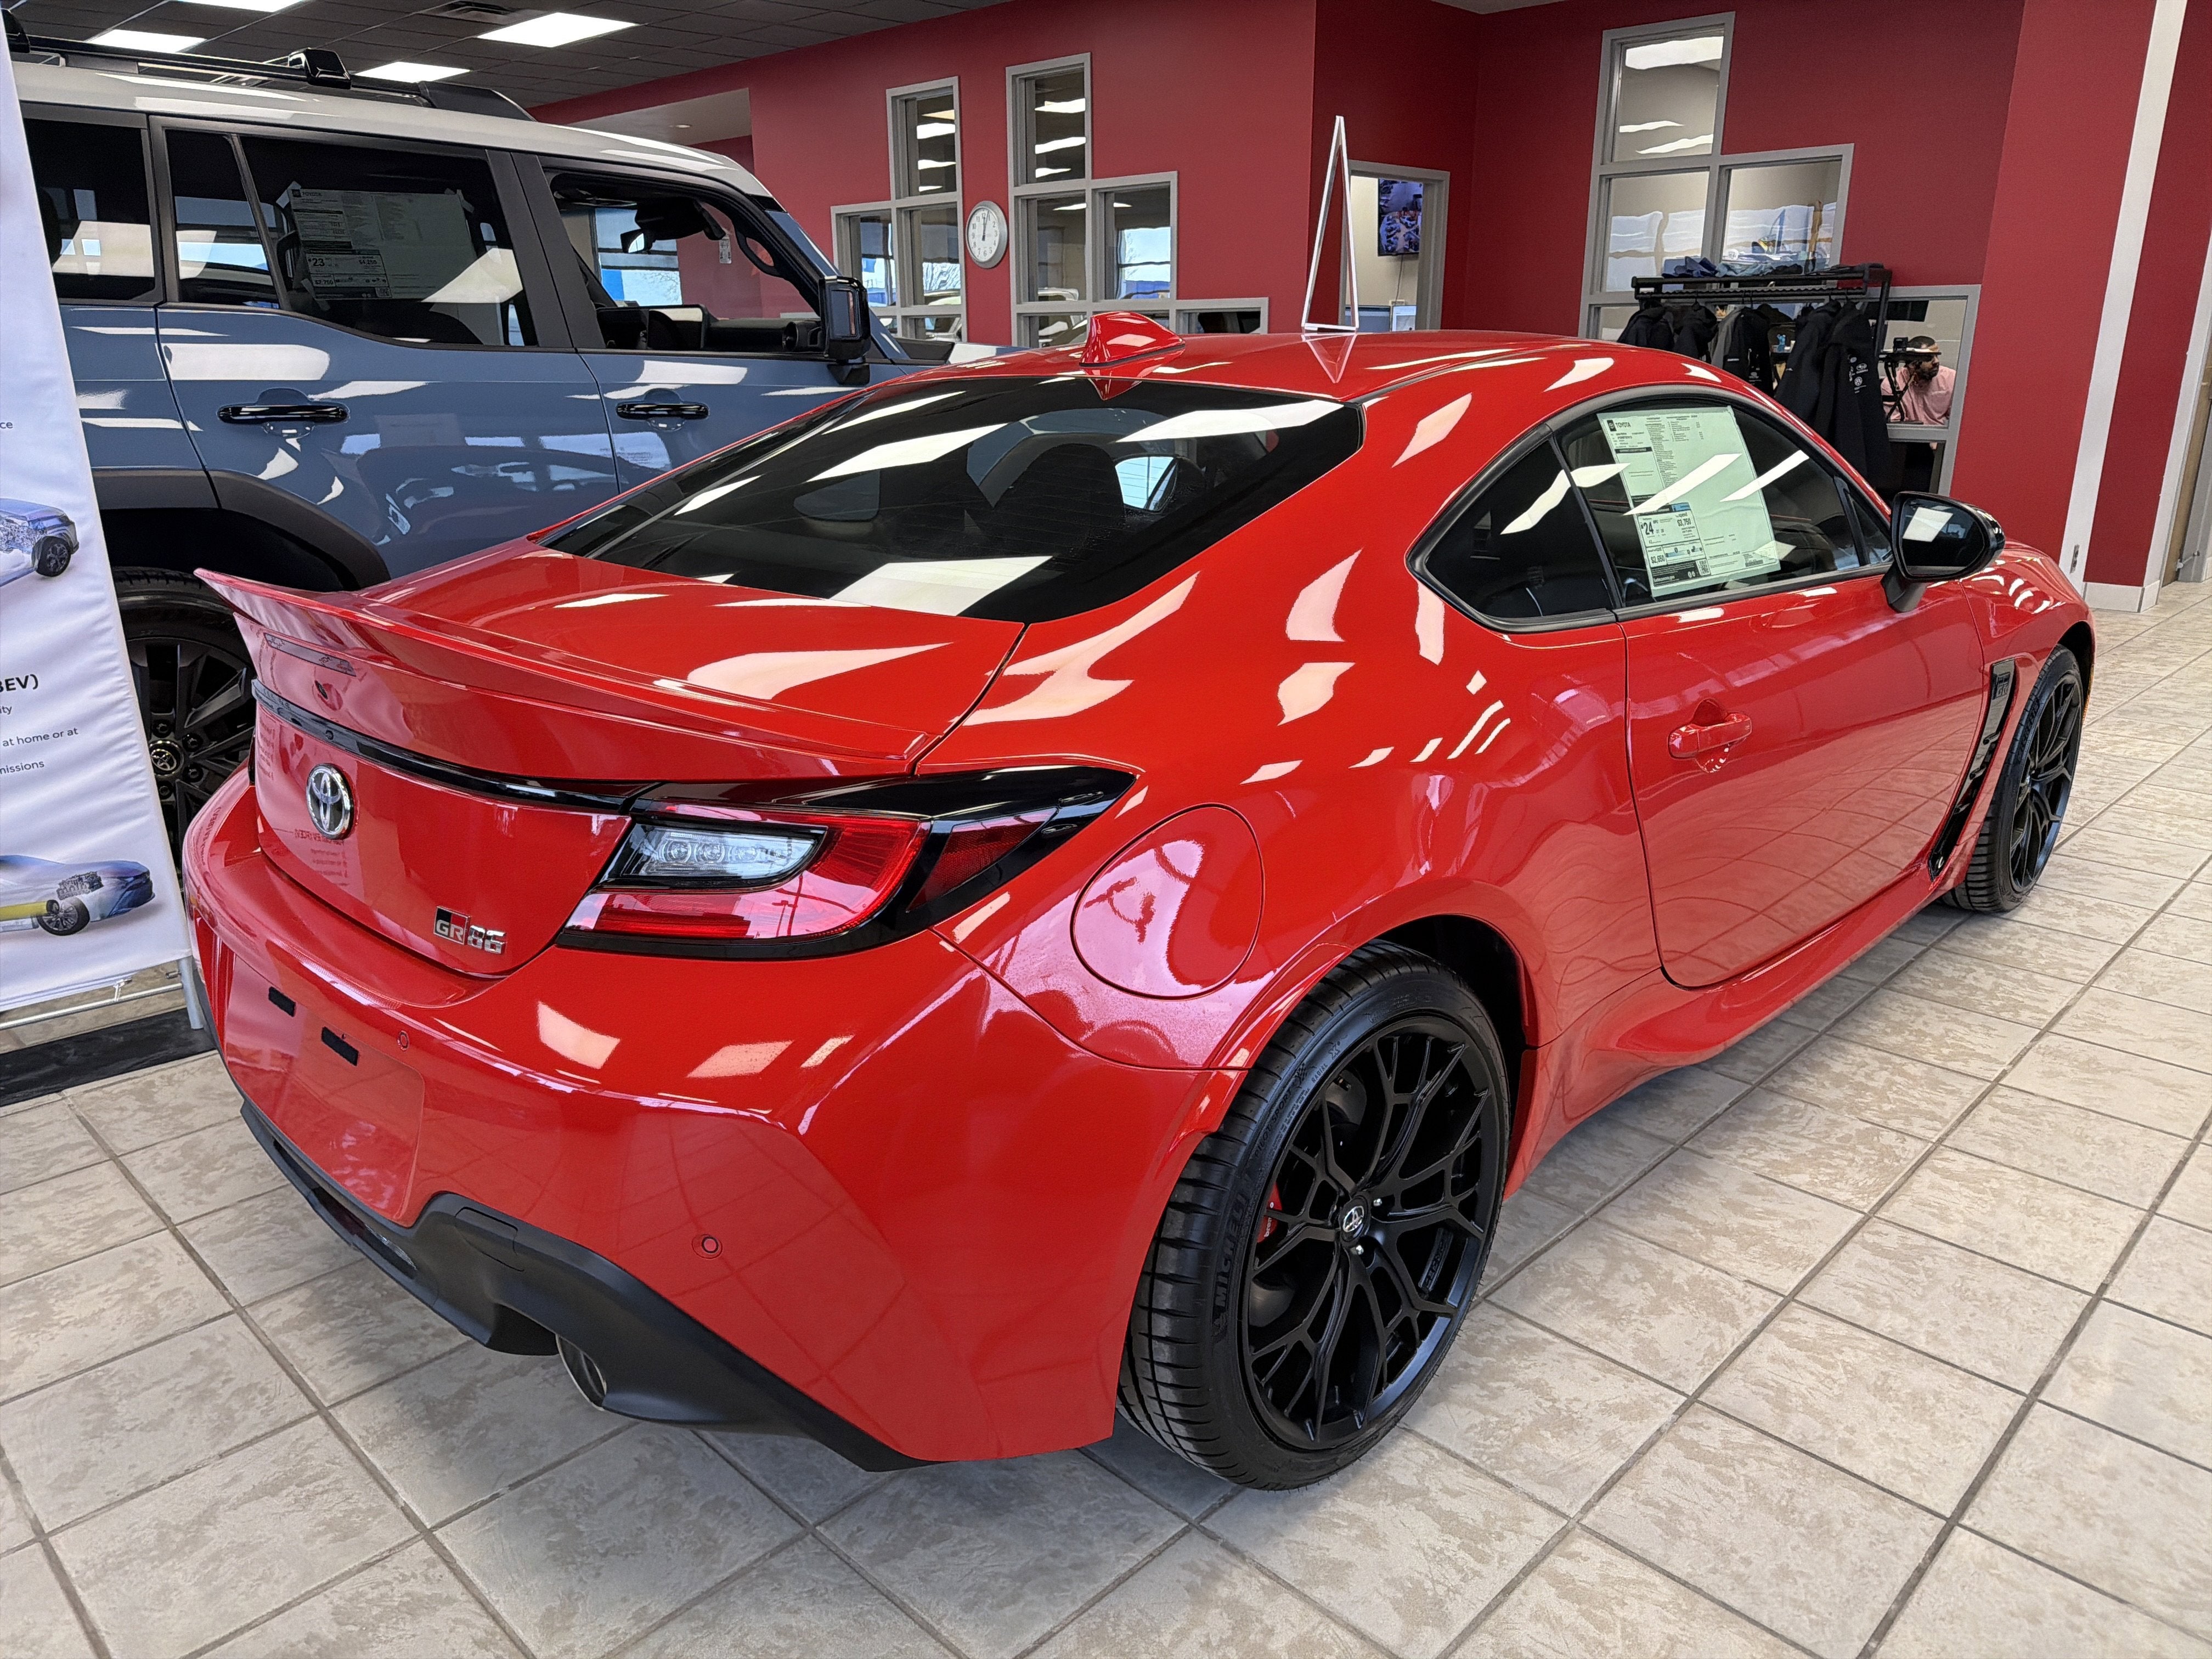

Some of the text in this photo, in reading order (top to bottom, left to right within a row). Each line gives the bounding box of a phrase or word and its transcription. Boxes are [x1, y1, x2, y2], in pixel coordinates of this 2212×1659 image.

[312, 258, 325, 267] 23
[1644, 522, 1654, 535] 24
[0, 674, 39, 692] EV)
[16, 734, 50, 744] home
[53, 730, 64, 738] or
[67, 727, 78, 736] at
[1254, 1125, 1272, 1158] PILOT
[1271, 1088, 1293, 1123] SPORT
